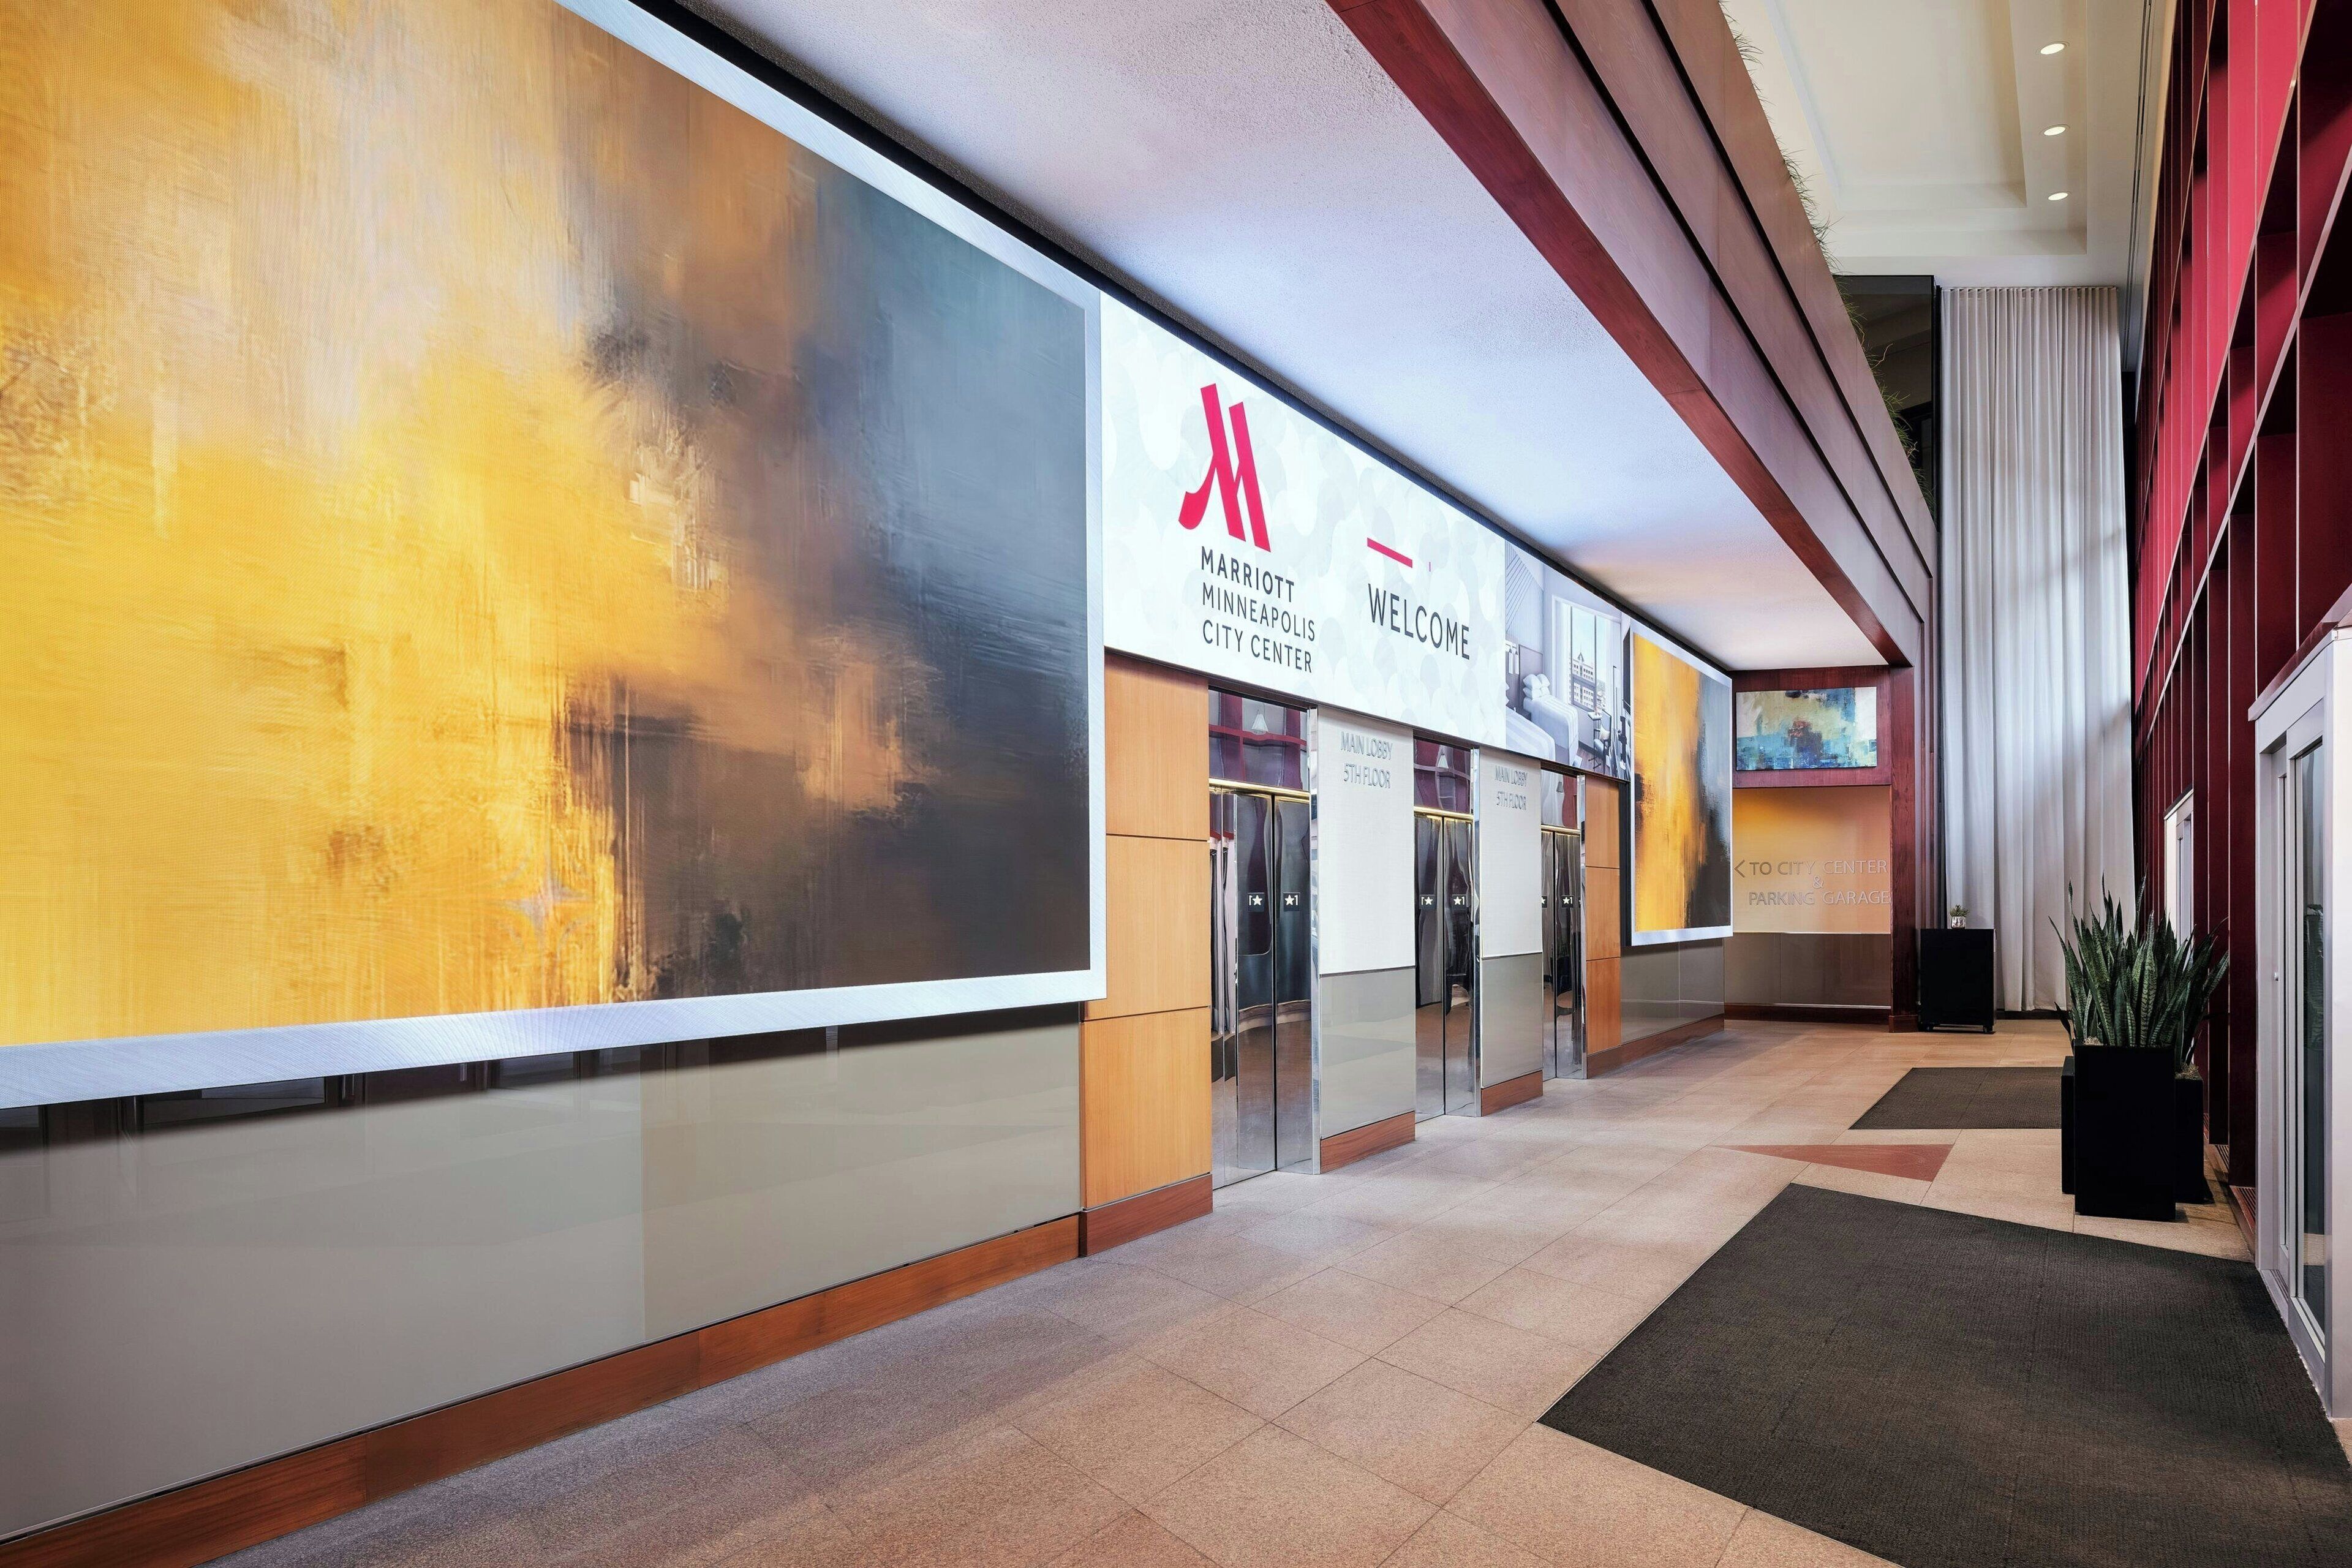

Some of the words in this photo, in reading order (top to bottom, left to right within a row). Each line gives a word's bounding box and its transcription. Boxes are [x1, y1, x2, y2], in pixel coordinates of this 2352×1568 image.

[1201, 546, 1294, 603] MARRIOTT
[1203, 582, 1315, 641] MINNEAPOLIS
[1368, 583, 1470, 660] WELCOME
[1203, 619, 1243, 652] CITY
[1251, 635, 1311, 673] CENTER
[1340, 731, 1364, 755] MAIN
[1366, 737, 1393, 761] LOBBY
[1344, 763, 1362, 784] 5TH
[1363, 766, 1391, 789] FLOOR
[1494, 765, 1510, 783] MAIN
[1511, 769, 1528, 787] LOBBY
[1496, 791, 1508, 807] 5TH
[1509, 793, 1526, 810] FLOOR
[1749, 861, 1772, 875] TO
[1777, 861, 1815, 875] CITY
[1823, 860, 1888, 875] CENTER
[1813, 875, 1824, 889] &
[1749, 891, 1815, 905] PARKING
[1823, 890, 1891, 905] GARAGE
